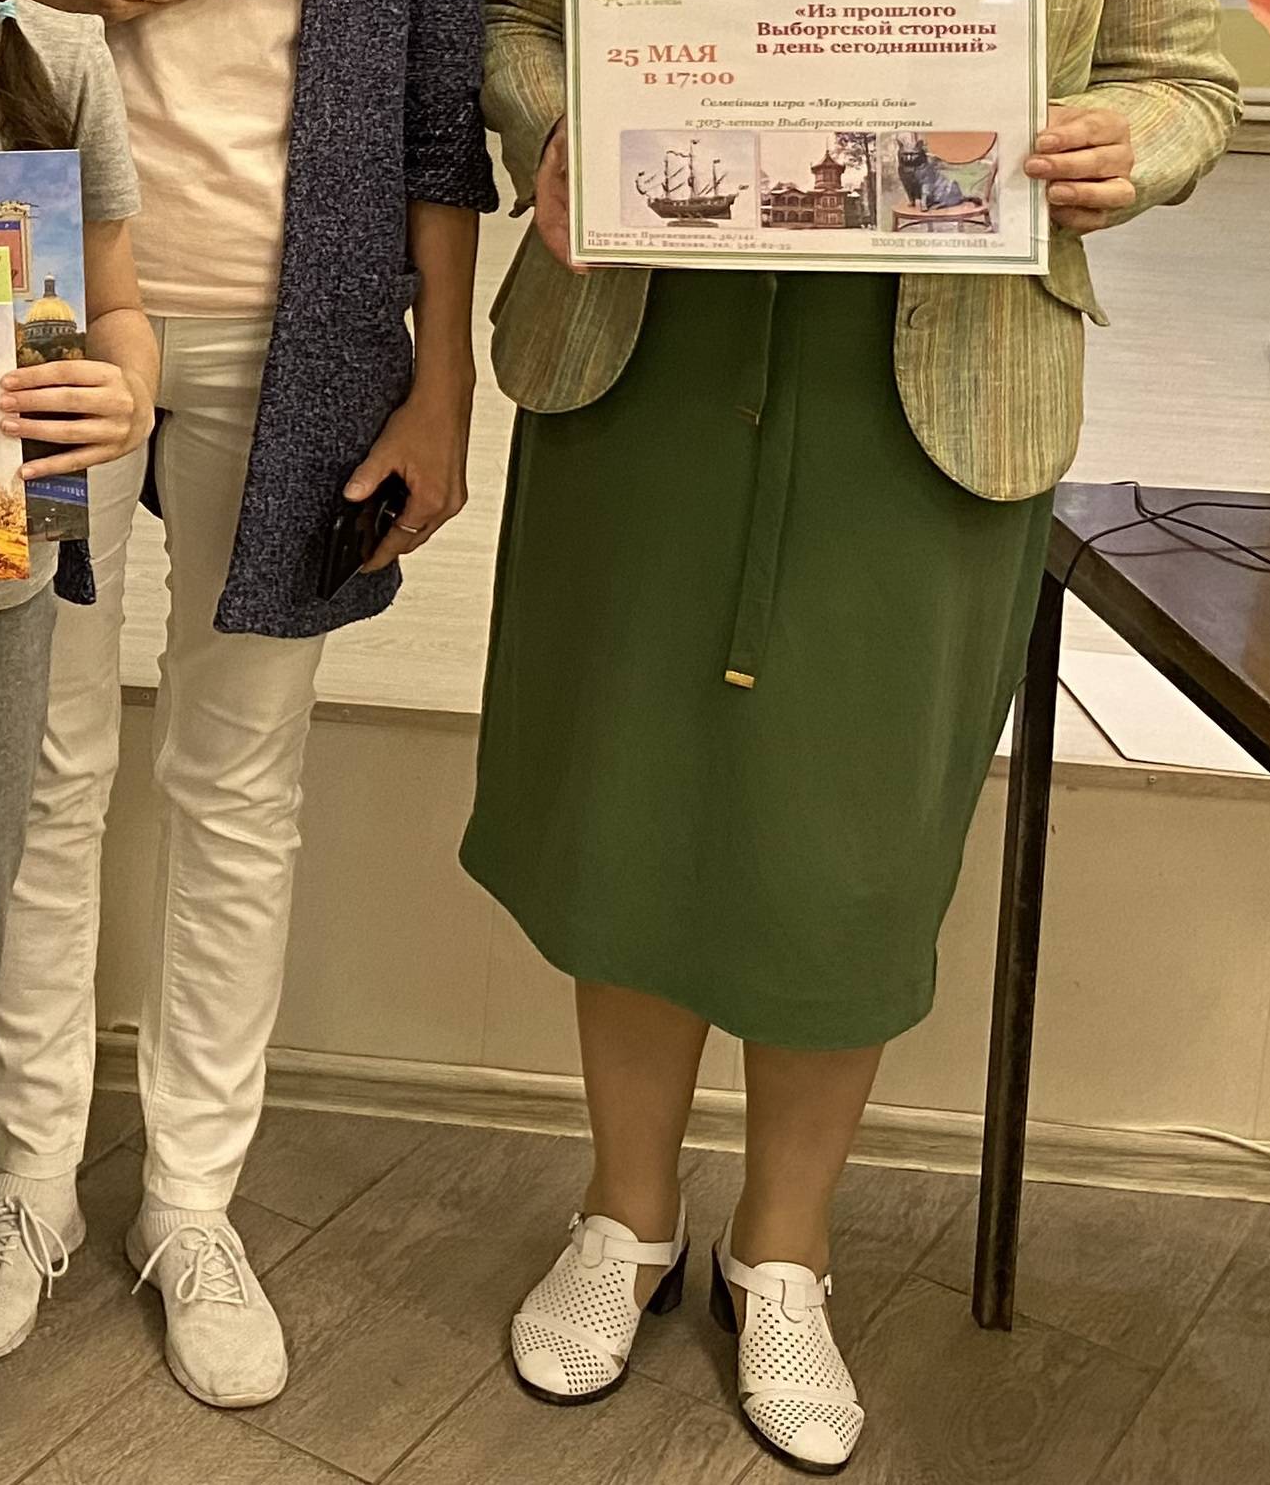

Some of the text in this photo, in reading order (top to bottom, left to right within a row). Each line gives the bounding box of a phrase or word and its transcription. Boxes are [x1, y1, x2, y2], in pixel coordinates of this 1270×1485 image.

[794, 3, 957, 21] «Из прошлого
[757, 20, 998, 40] Выборгской стороны
[607, 44, 718, 67] 25 МАЯ
[756, 38, 999, 56] в день сегодняшний»
[665, 71, 735, 89] 17:00
[700, 97, 916, 110] Семейная игра «Морской бой»
[777, 118, 863, 130] Выборгской
[866, 120, 934, 130] стороны
